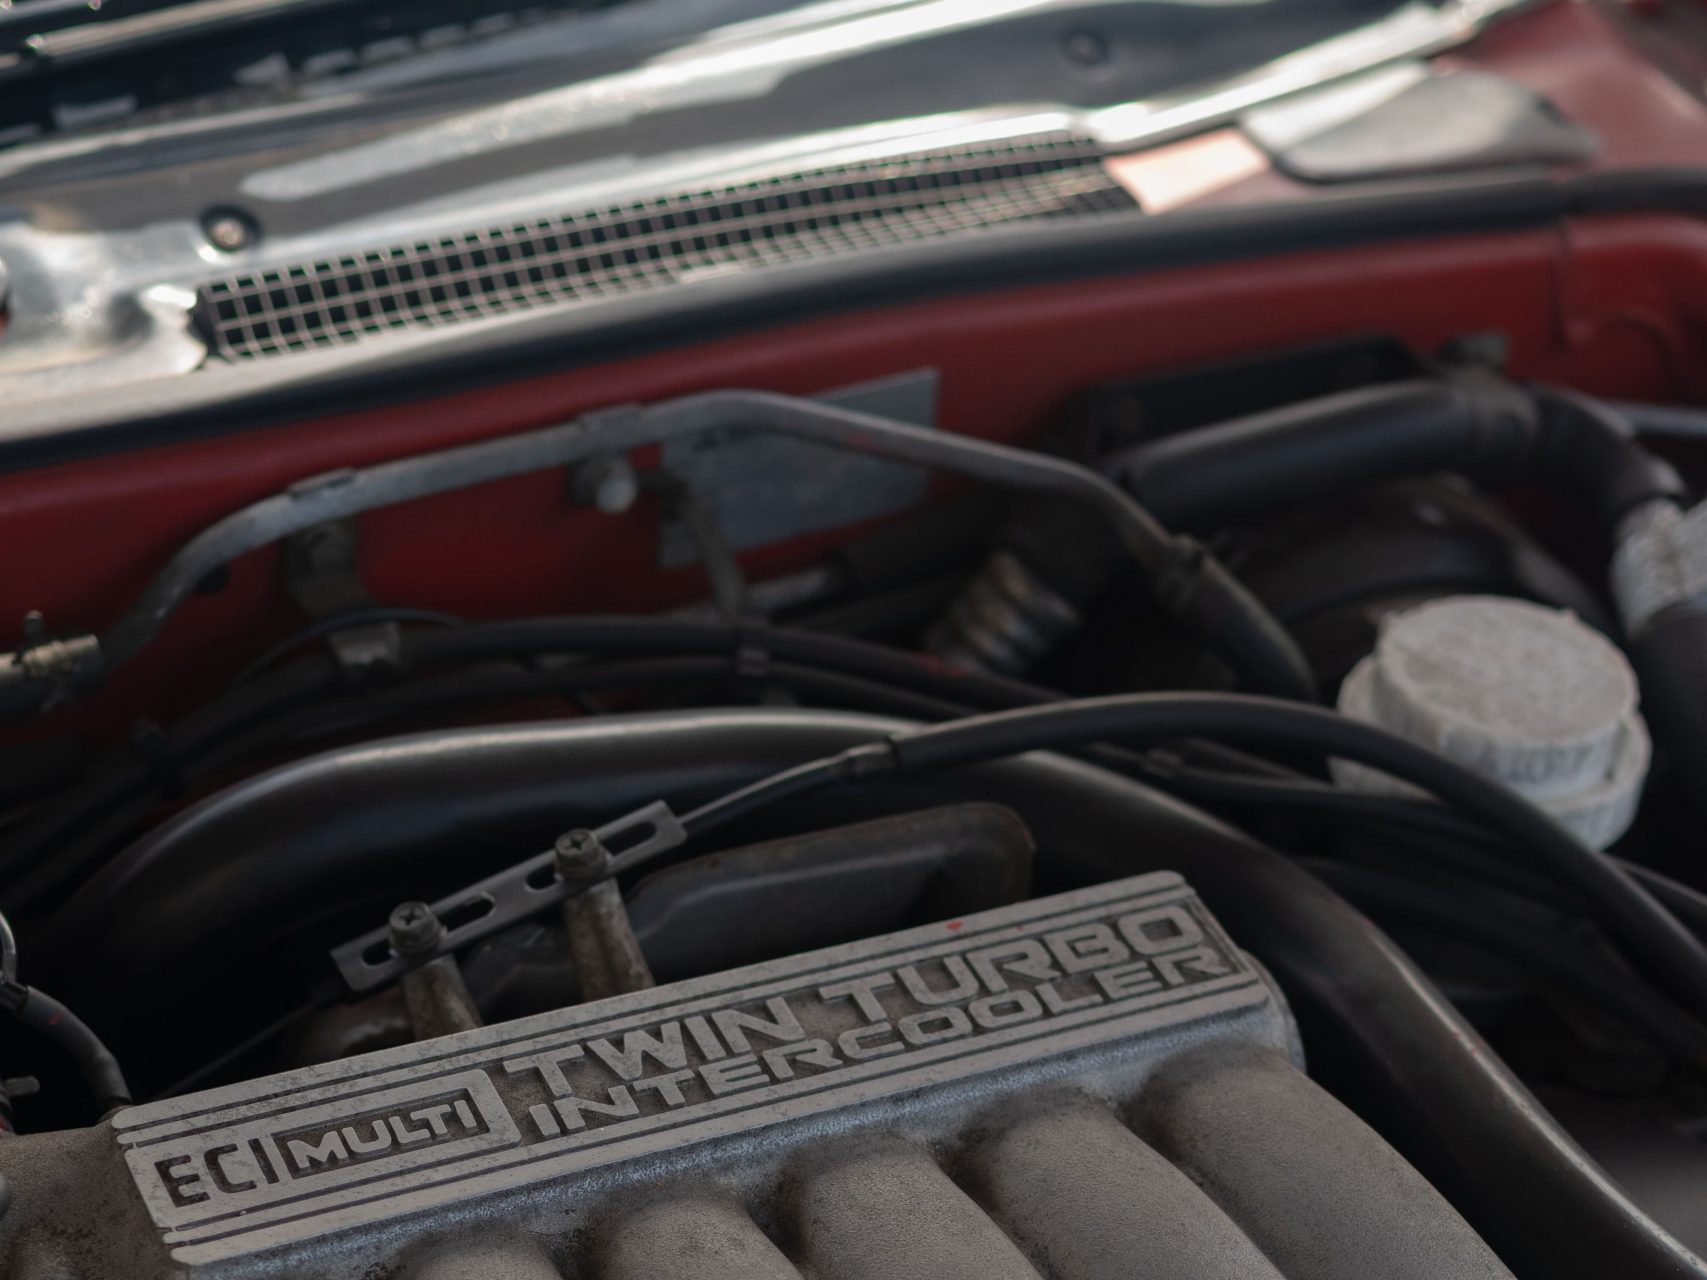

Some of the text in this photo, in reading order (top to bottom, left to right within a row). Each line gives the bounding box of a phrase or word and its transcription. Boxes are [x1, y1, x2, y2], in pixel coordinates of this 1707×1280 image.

[503, 905, 1205, 1099] TWIN TURBO
[528, 944, 1231, 1139] INTERCOOLER
[154, 1100, 478, 1208] ECI MULTI
